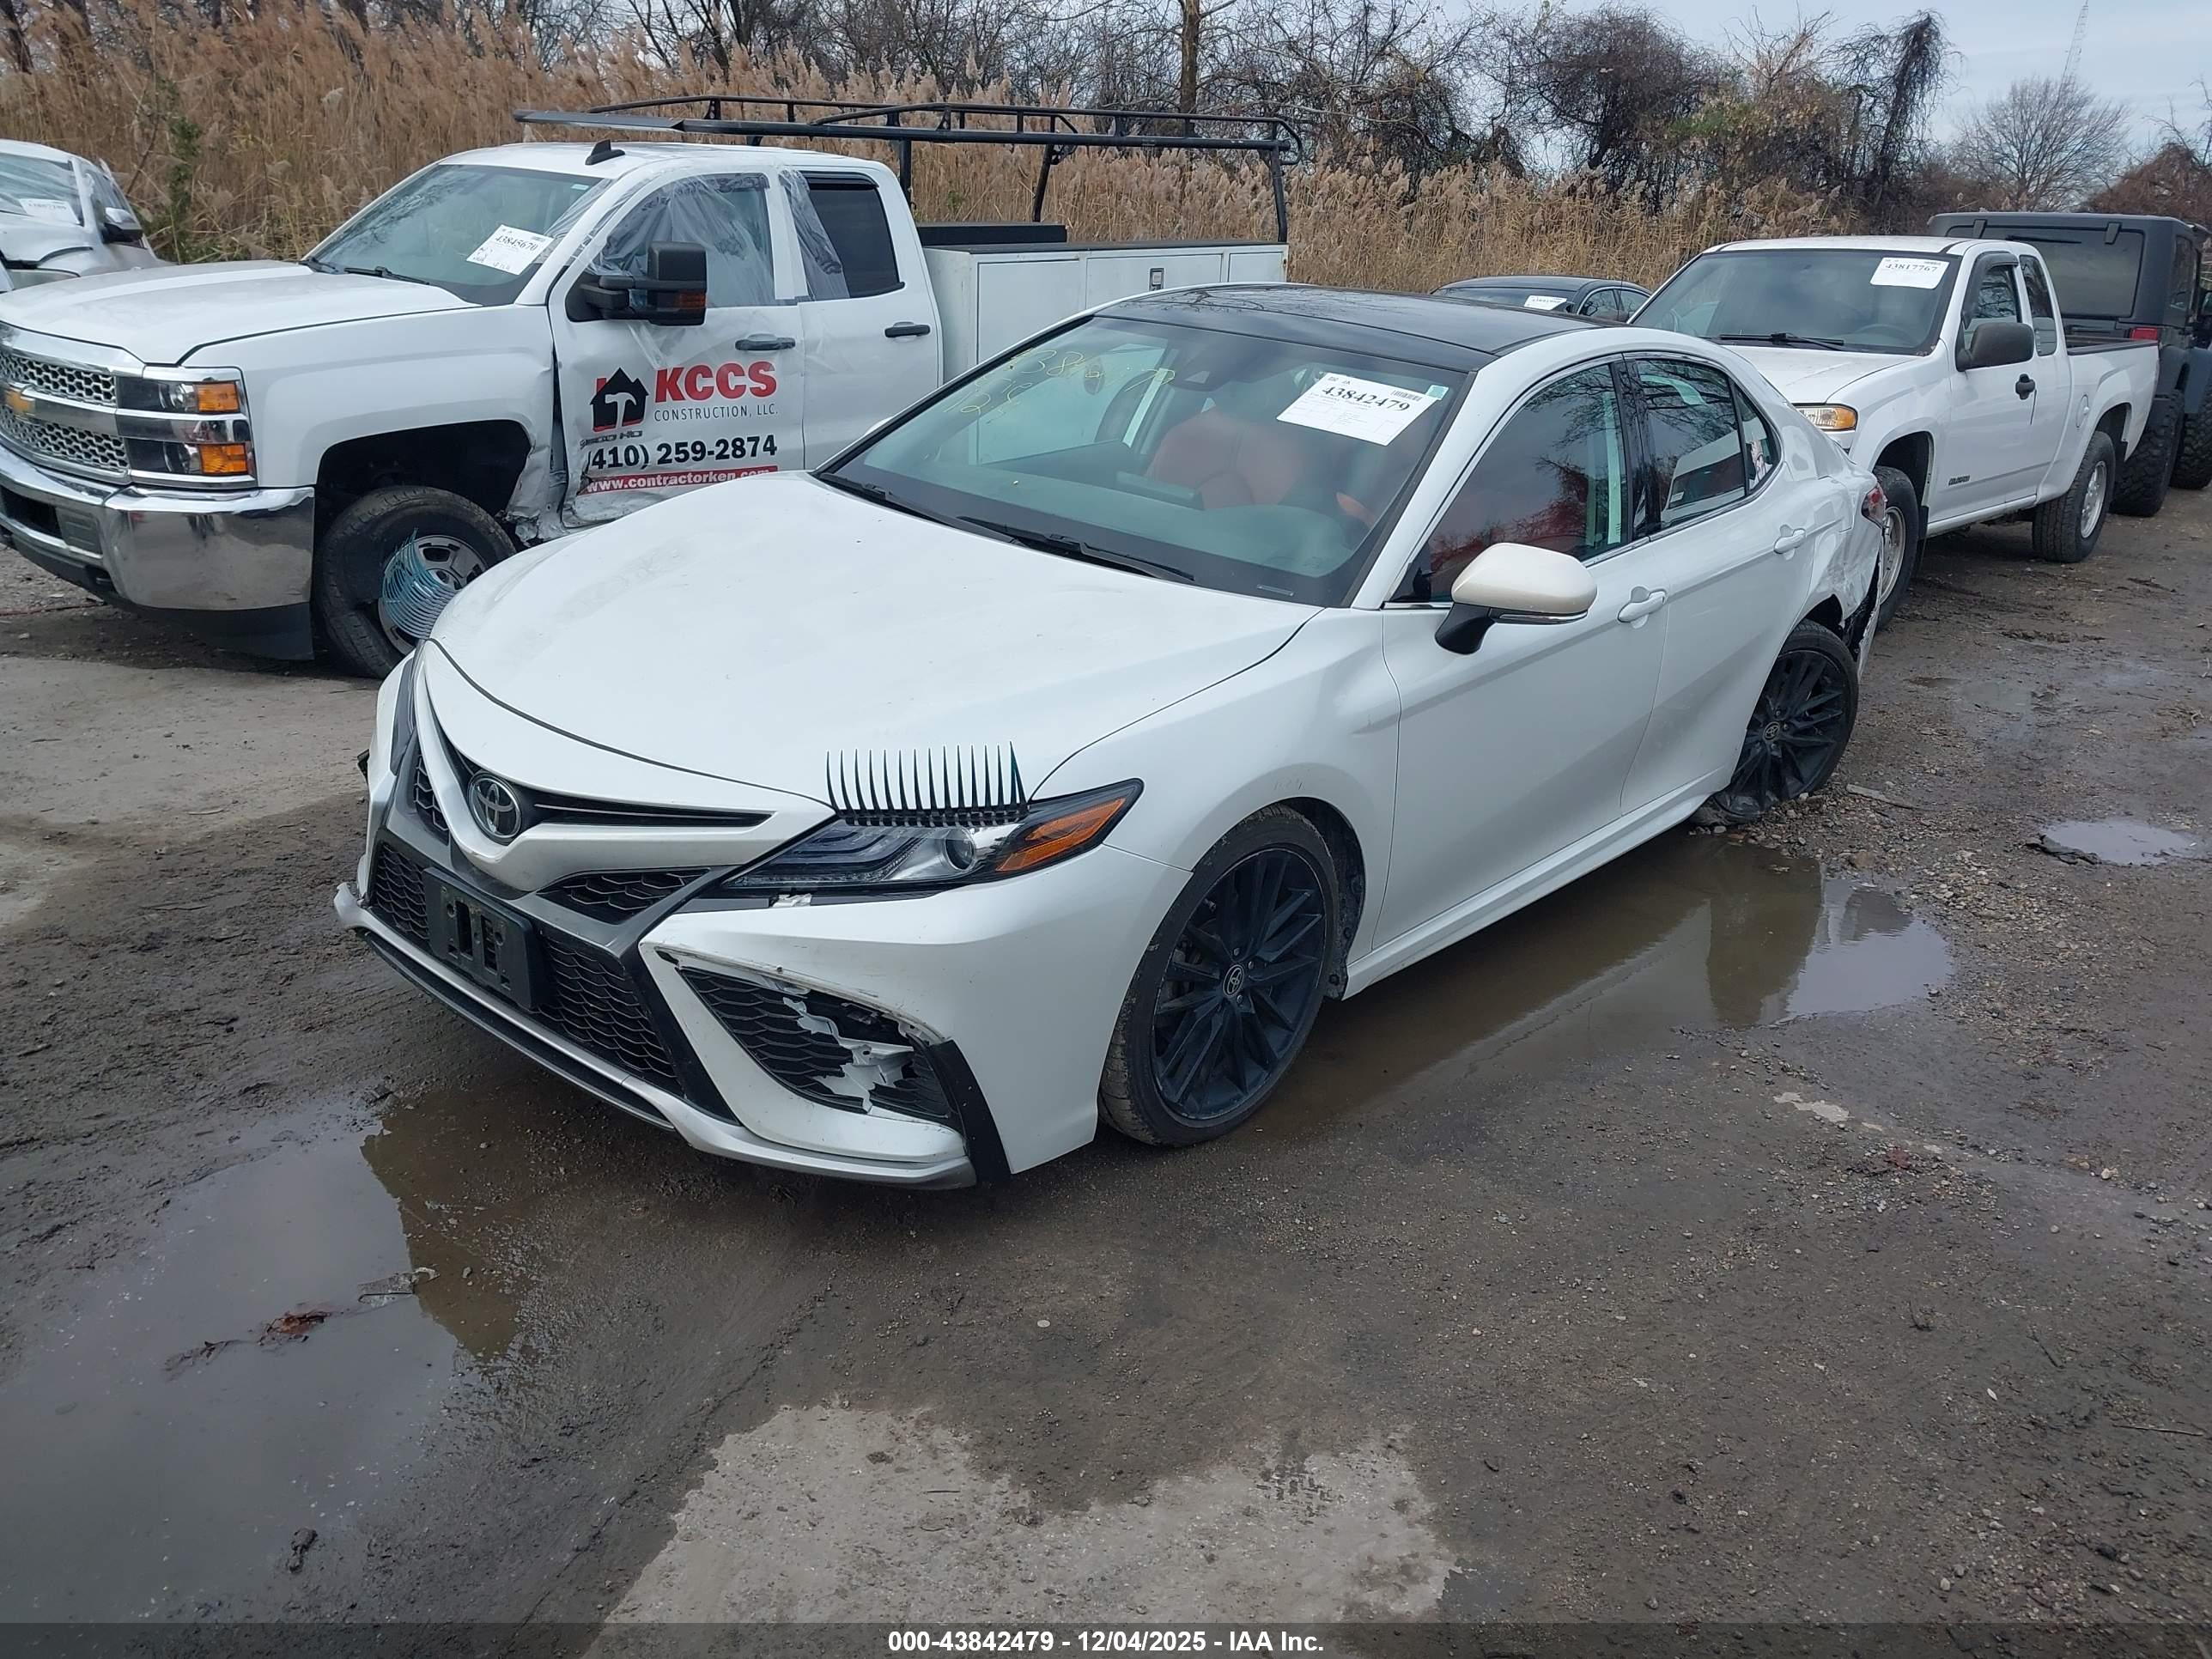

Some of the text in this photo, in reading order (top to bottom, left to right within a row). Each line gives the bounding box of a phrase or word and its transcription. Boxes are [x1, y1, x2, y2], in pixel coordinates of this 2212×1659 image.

[495, 234, 538, 252] 43845670
[655, 361, 777, 403] KCCS
[1322, 386, 1411, 411] 43842479
[654, 404, 778, 422] CONSTRUCTION, LLC.
[587, 434, 778, 470] (410) 259-2874
[586, 469, 769, 492] www.contractorkenc
